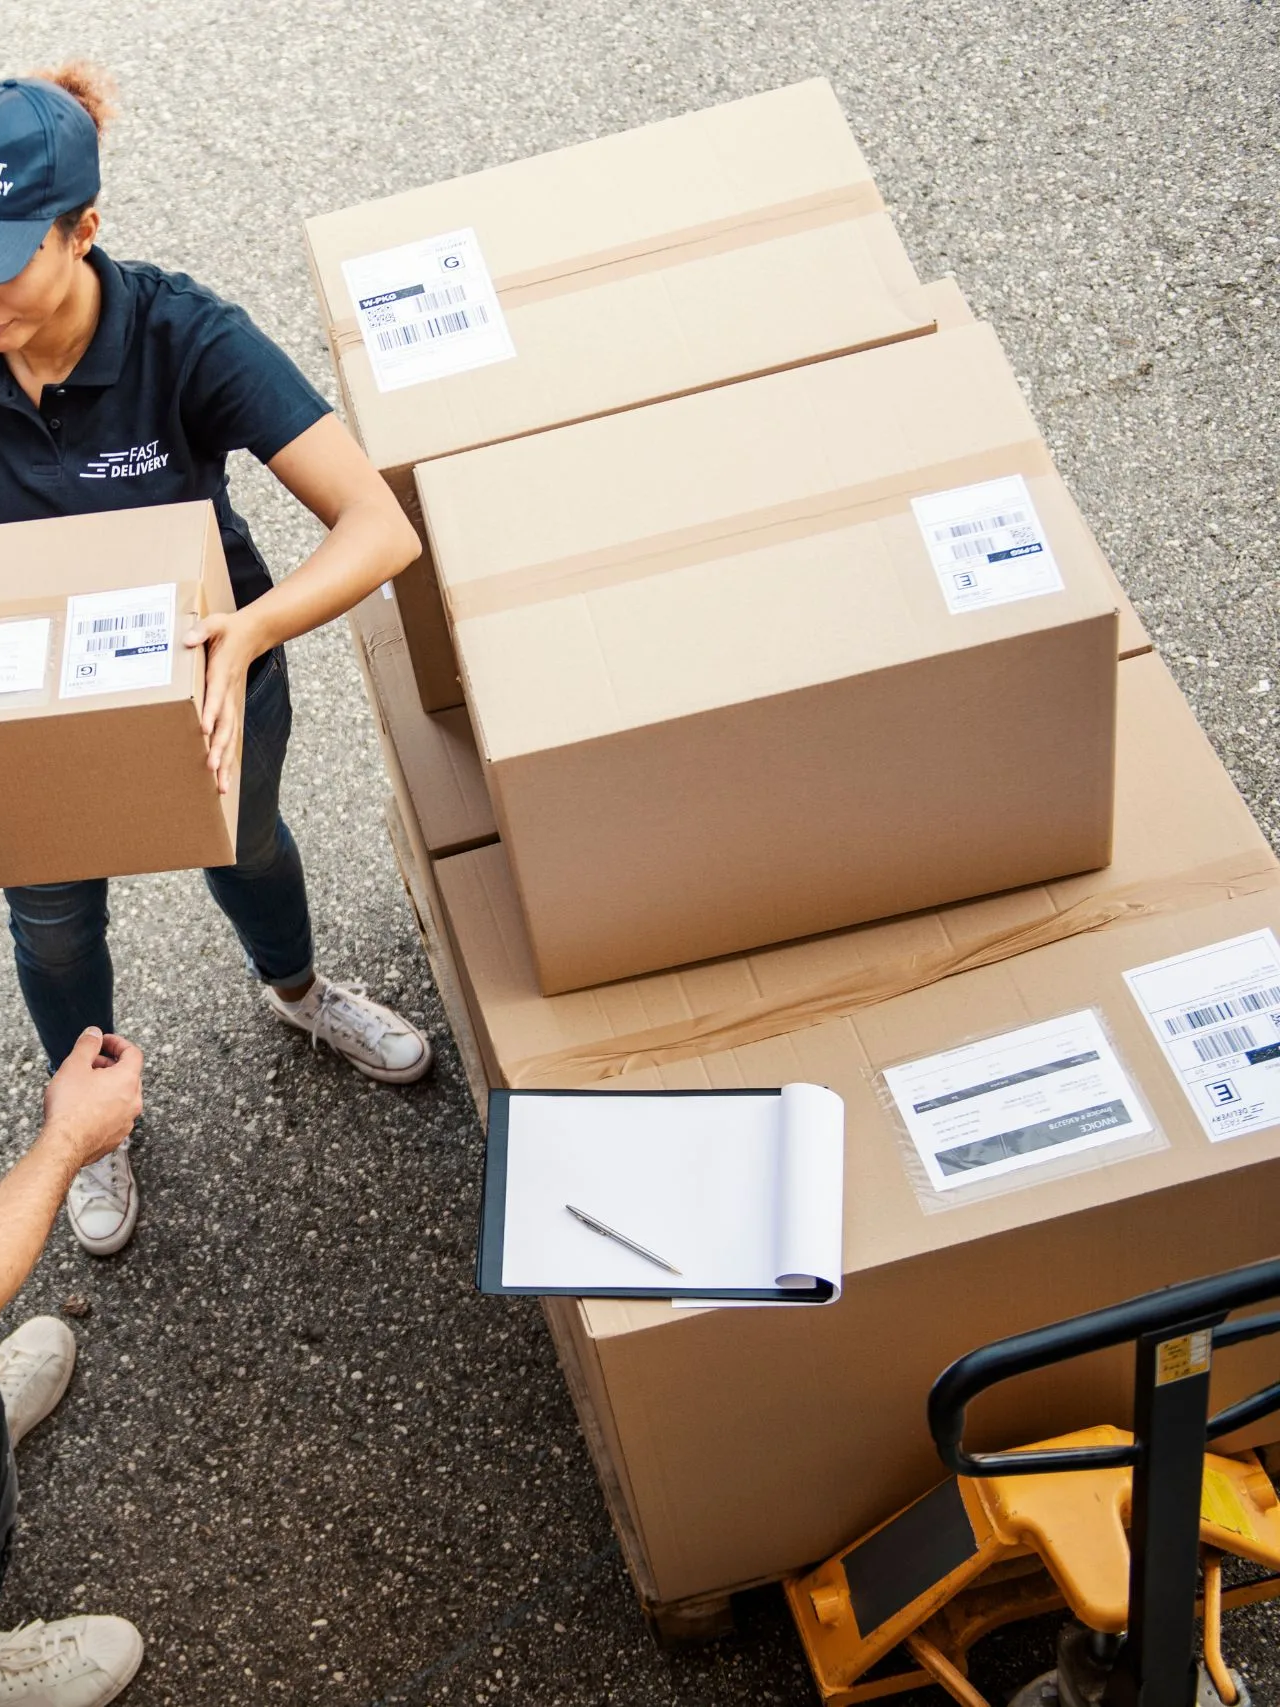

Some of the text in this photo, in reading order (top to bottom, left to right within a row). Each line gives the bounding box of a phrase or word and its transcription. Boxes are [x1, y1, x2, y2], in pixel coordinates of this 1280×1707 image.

[442, 255, 460, 269] G
[129, 440, 159, 462] FAST
[110, 453, 169, 478] DELIVERY
[959, 574, 972, 587] E
[80, 666, 93, 676] G
[1213, 1083, 1234, 1102] E
[1080, 1116, 1118, 1133] INVOICE
